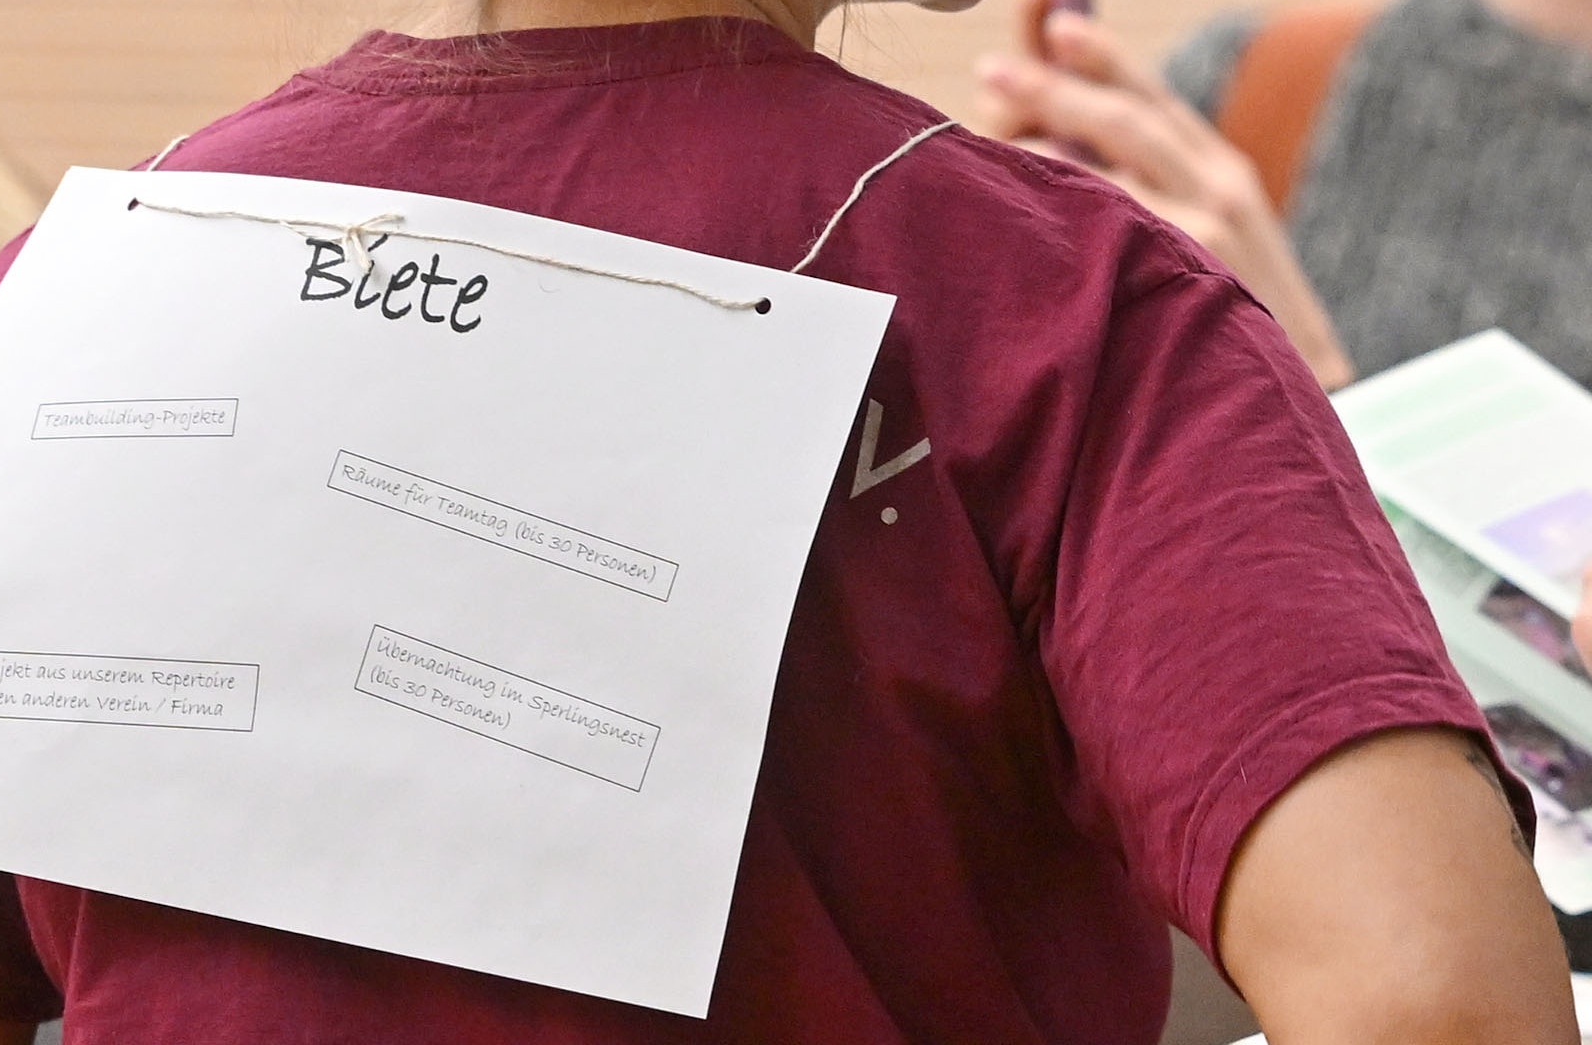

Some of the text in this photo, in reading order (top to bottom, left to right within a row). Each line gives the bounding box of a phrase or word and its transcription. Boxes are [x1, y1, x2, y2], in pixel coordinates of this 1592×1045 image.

[300, 233, 488, 333] Biete
[45, 407, 226, 431] Teambuilding-Projekte
[342, 464, 657, 583] Räume für Teamtag (bis 30 Personen)
[22, 691, 90, 708] anderen
[96, 694, 151, 712] Verein
[155, 698, 166, 714] /
[171, 697, 224, 716] Firma
[36, 665, 66, 680] aus
[71, 668, 144, 684] unserem
[151, 670, 236, 692] Repertoire
[370, 664, 511, 730] (bis 30 Personen)
[377, 636, 646, 748] Übernachtung im Sperlingsnest
